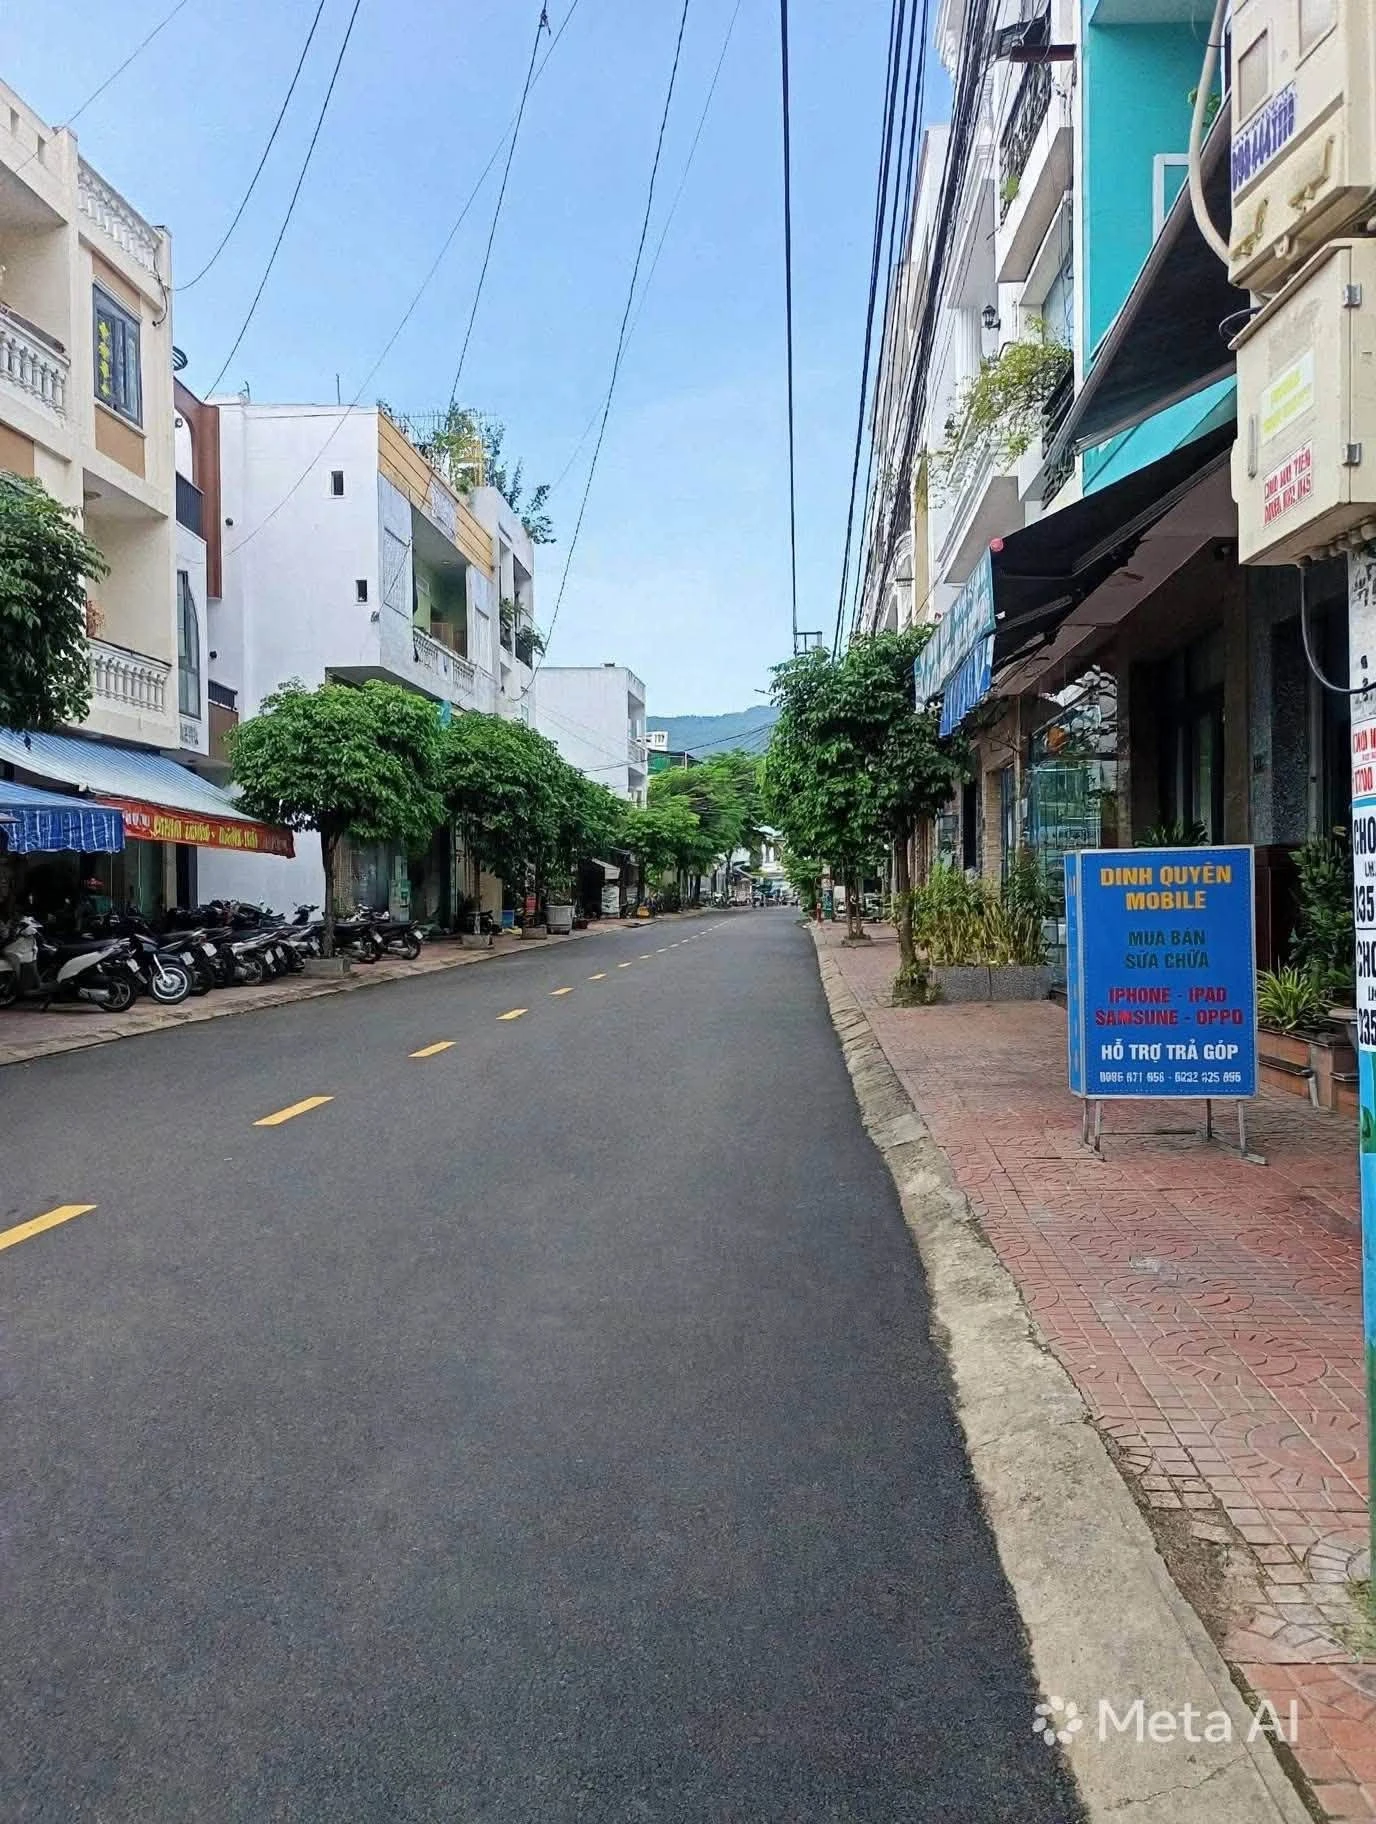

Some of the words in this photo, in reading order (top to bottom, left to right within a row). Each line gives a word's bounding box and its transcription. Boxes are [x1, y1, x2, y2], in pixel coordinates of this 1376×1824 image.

[1126, 890, 1207, 910] MOBILE
[1128, 930, 1165, 946] MUA
[1109, 987, 1170, 1003] IPHONE
[1189, 987, 1227, 1003] IPAD
[1196, 1009, 1243, 1025] OPPO
[1101, 1038, 1124, 1060] HỖ
[1128, 1043, 1162, 1063] TRỢ
[1166, 1039, 1198, 1060] TRẢ
[1203, 1039, 1239, 1060] GÓP
